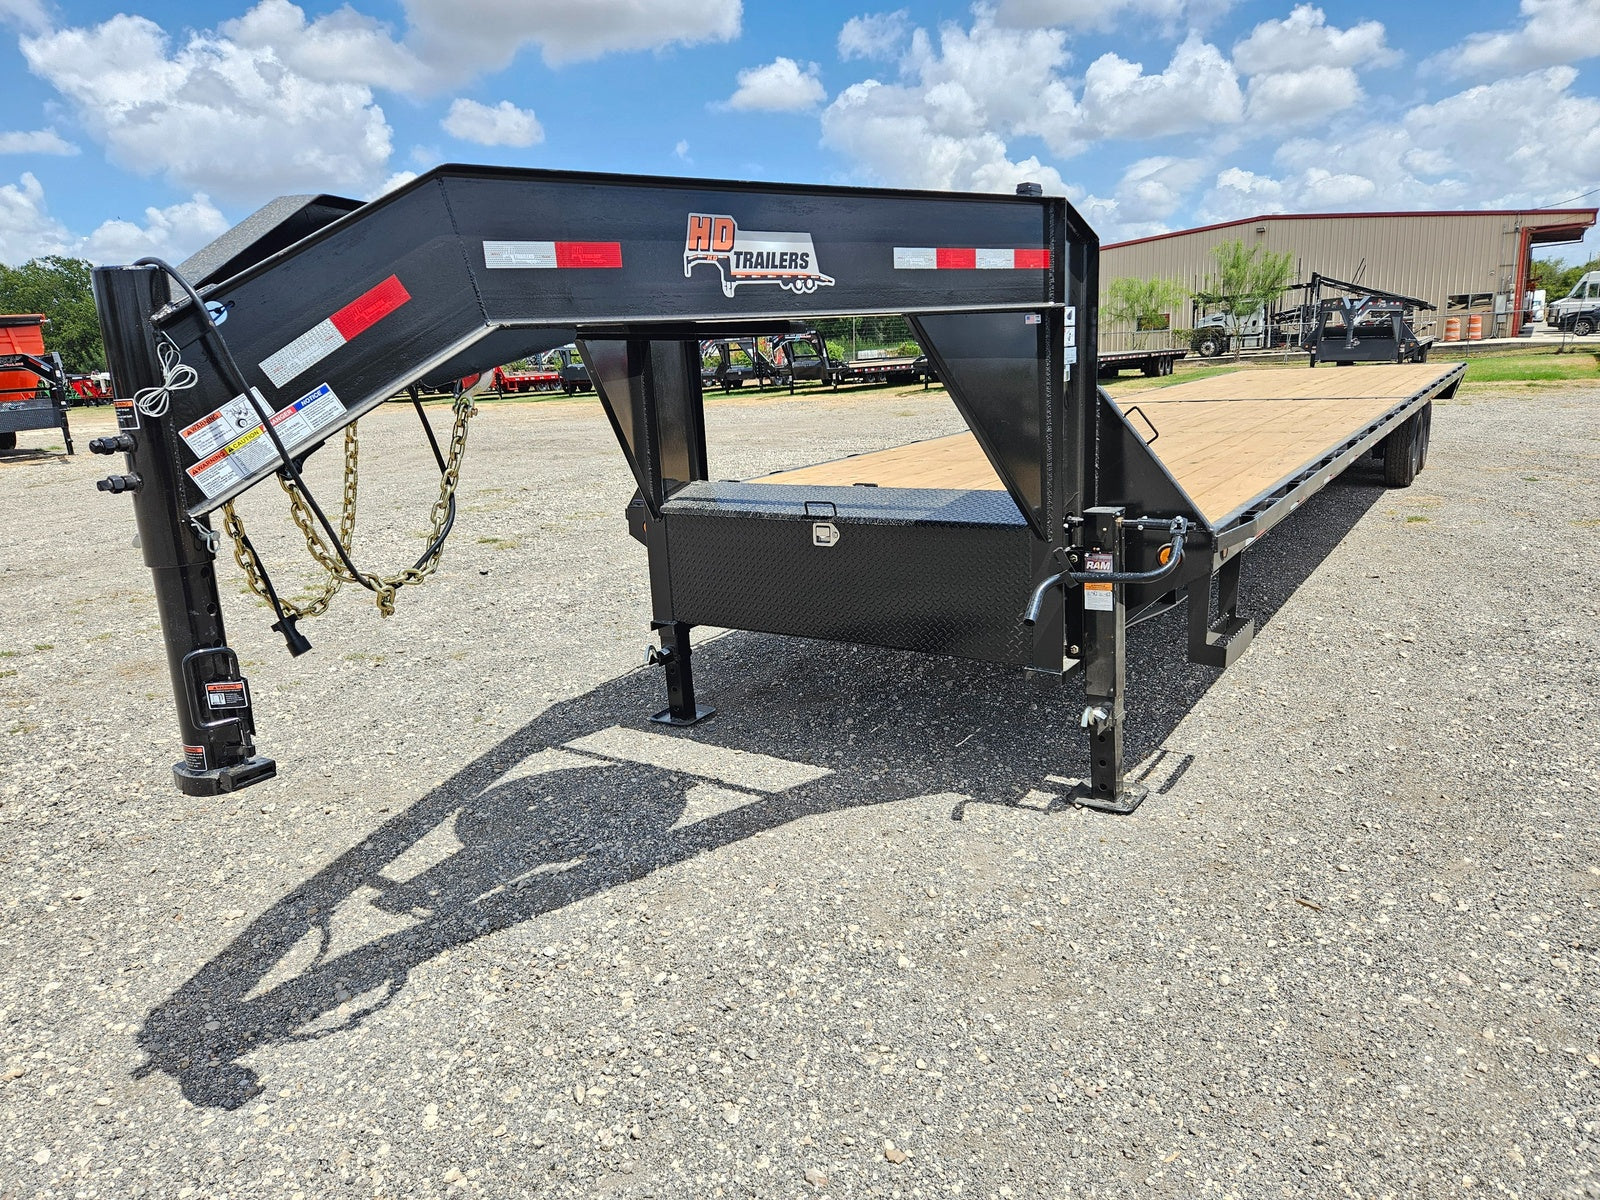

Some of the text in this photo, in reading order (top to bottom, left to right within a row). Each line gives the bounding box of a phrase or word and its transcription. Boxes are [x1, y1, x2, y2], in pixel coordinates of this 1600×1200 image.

[688, 216, 735, 252] HD
[734, 251, 810, 270] TRAILERS
[301, 390, 322, 406] NOTICE
[190, 413, 219, 431] WARNING
[233, 430, 260, 449] CAUTION
[196, 451, 226, 472] WARNING
[1086, 560, 1110, 570] RAM
